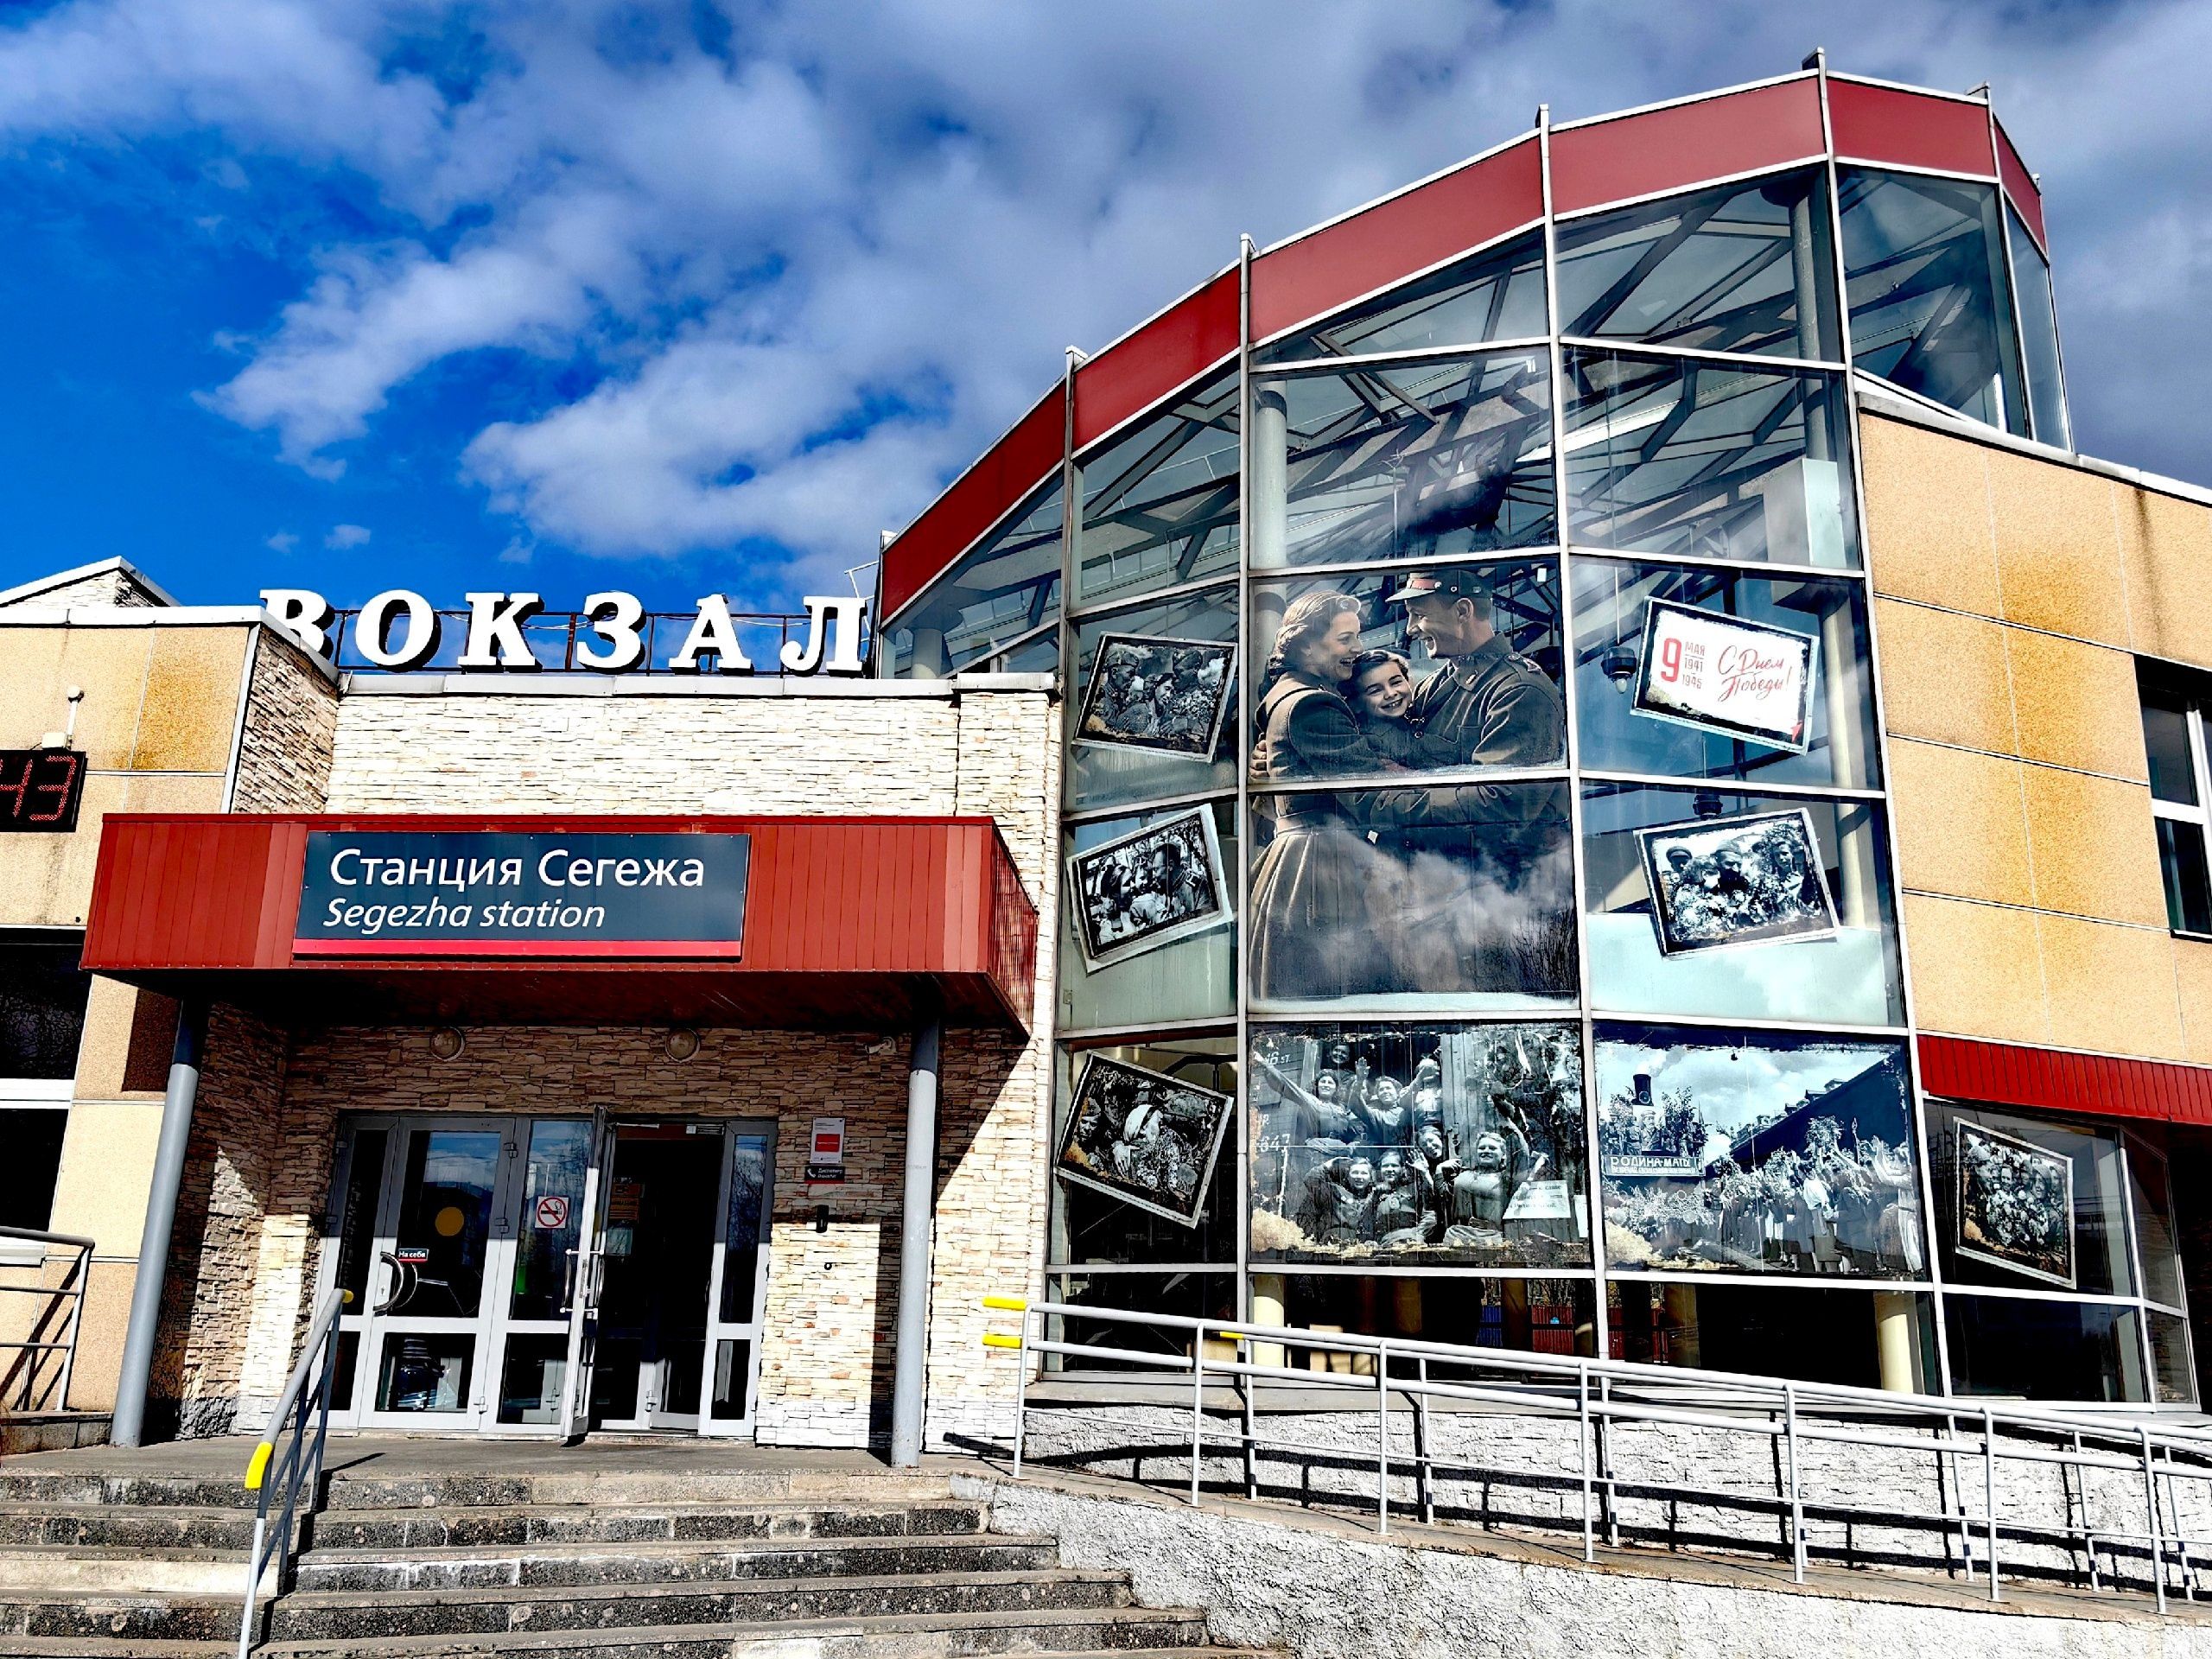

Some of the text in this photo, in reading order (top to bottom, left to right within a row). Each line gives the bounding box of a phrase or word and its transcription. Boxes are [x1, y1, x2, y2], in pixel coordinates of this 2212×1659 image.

[259, 589, 866, 671] ВОКЗАЛ
[1661, 638, 1681, 682] 9
[1684, 658, 1703, 672] 1941
[1685, 641, 1706, 656] МАЯ
[1718, 645, 1737, 675] С
[1682, 674, 1703, 689] 1945
[1718, 666, 1792, 702] Победы!
[0, 755, 76, 821] 43
[329, 849, 704, 892] Станция Сегежа
[323, 897, 606, 934] Segezha station
